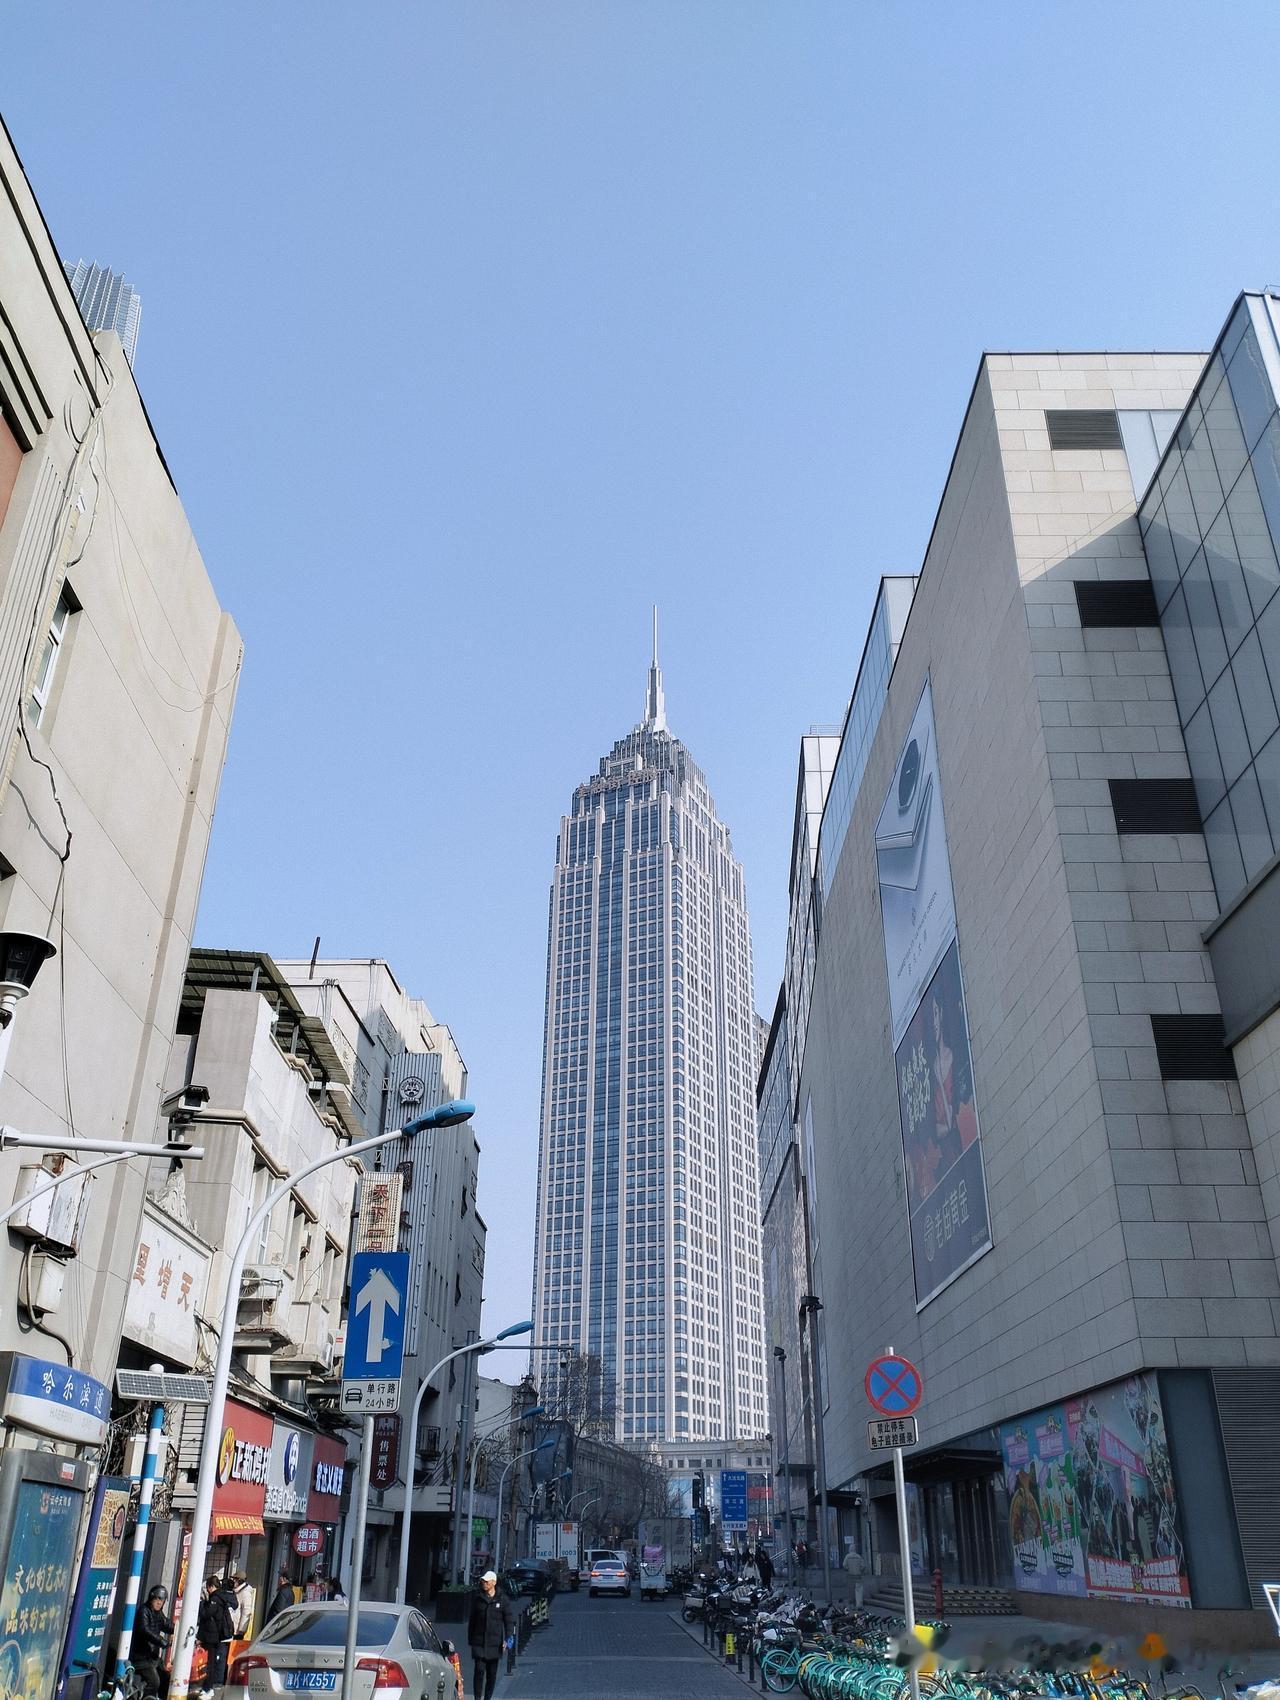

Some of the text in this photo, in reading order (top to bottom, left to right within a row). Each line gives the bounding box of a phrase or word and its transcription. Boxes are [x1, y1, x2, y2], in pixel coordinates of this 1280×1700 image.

[935, 1179, 970, 1248] 老庙黄金
[42, 1368, 105, 1415] 哈尔滨道
[367, 1383, 396, 1395] 单行路
[365, 1398, 396, 1409] 24小时
[877, 1420, 905, 1434] 禁止停车
[376, 1440, 390, 1481] 售票处
[298, 1528, 320, 1540] 烟酒
[297, 1541, 319, 1552] 超市
